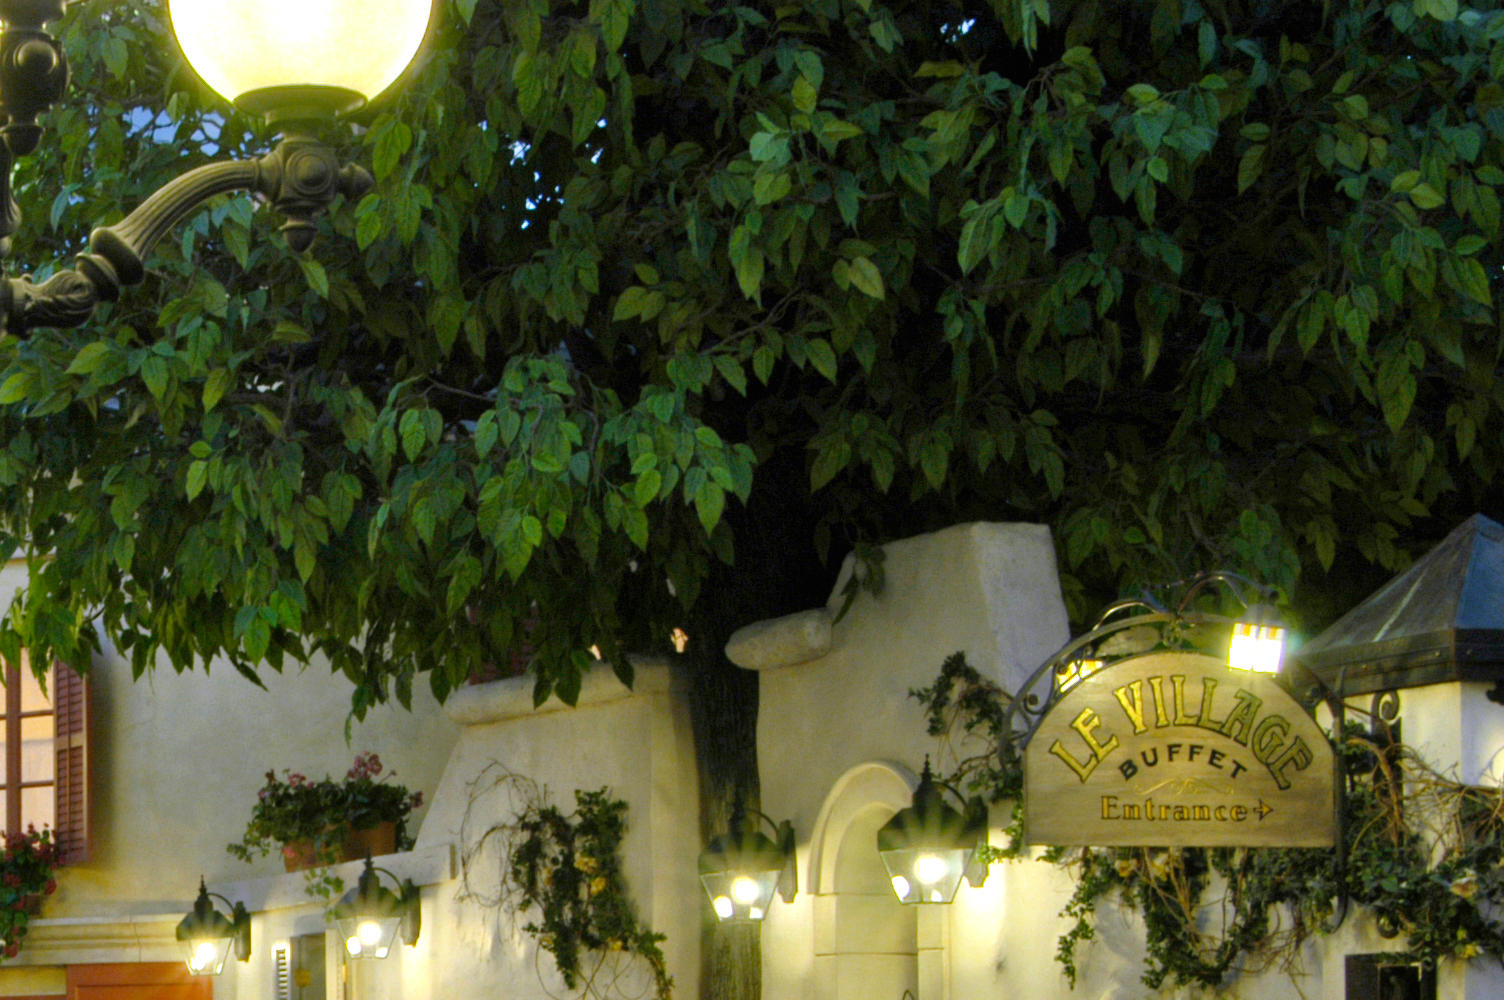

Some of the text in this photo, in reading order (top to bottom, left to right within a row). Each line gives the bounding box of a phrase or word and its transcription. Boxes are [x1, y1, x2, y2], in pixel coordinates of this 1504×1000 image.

[1049, 674, 1314, 791] LE VILLAGE
[1118, 743, 1248, 781] BUFFET
[1100, 795, 1248, 822] Entrance
